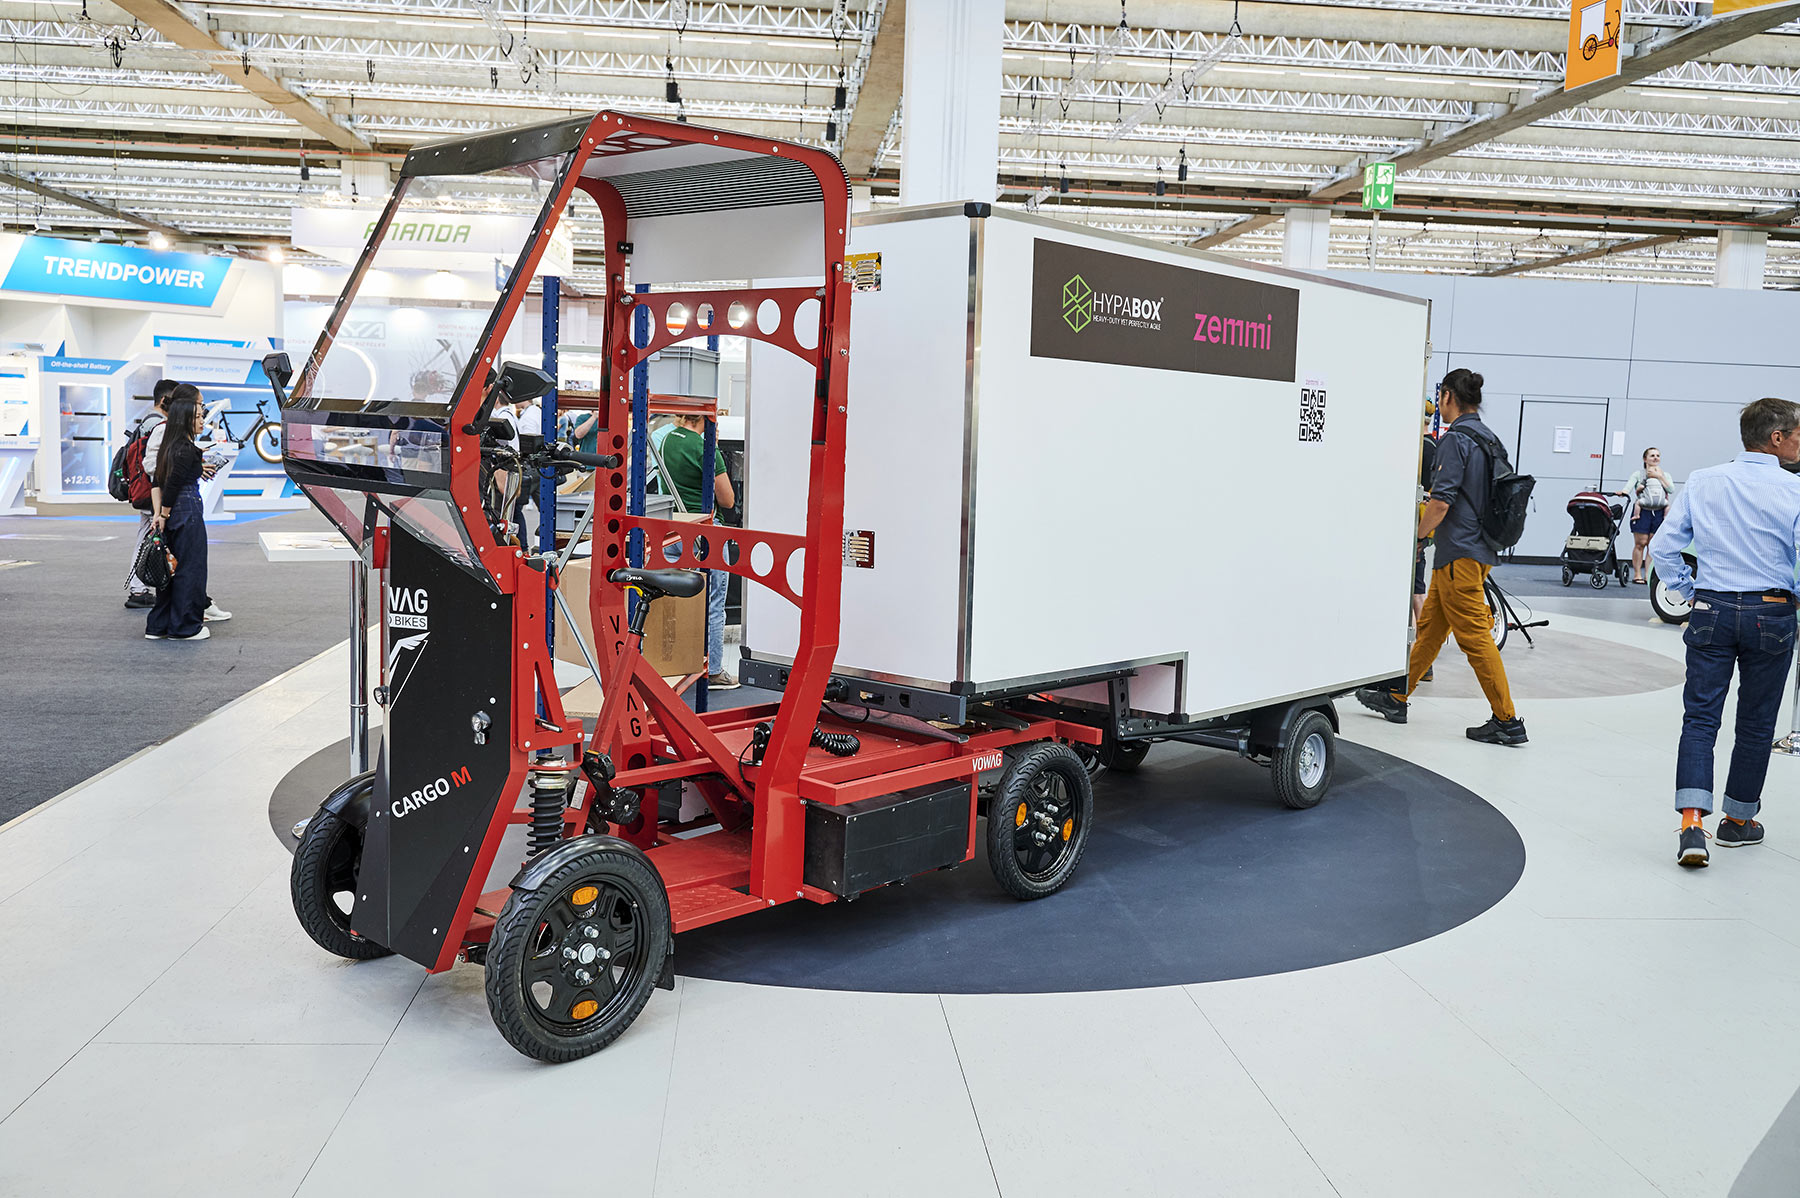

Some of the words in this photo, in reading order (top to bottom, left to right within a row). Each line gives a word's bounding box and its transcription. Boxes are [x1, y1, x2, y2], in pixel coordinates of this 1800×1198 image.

[44, 256, 205, 289] TRENDPOWER
[1120, 318, 1128, 326] YET
[1193, 313, 1272, 350] zemmi
[51, 361, 89, 369] Off-the-shelf
[89, 363, 111, 371] Battery
[64, 475, 100, 485] +12.5%
[394, 616, 427, 628] BIKES
[391, 778, 450, 818] CARGO
[450, 766, 472, 788] M
